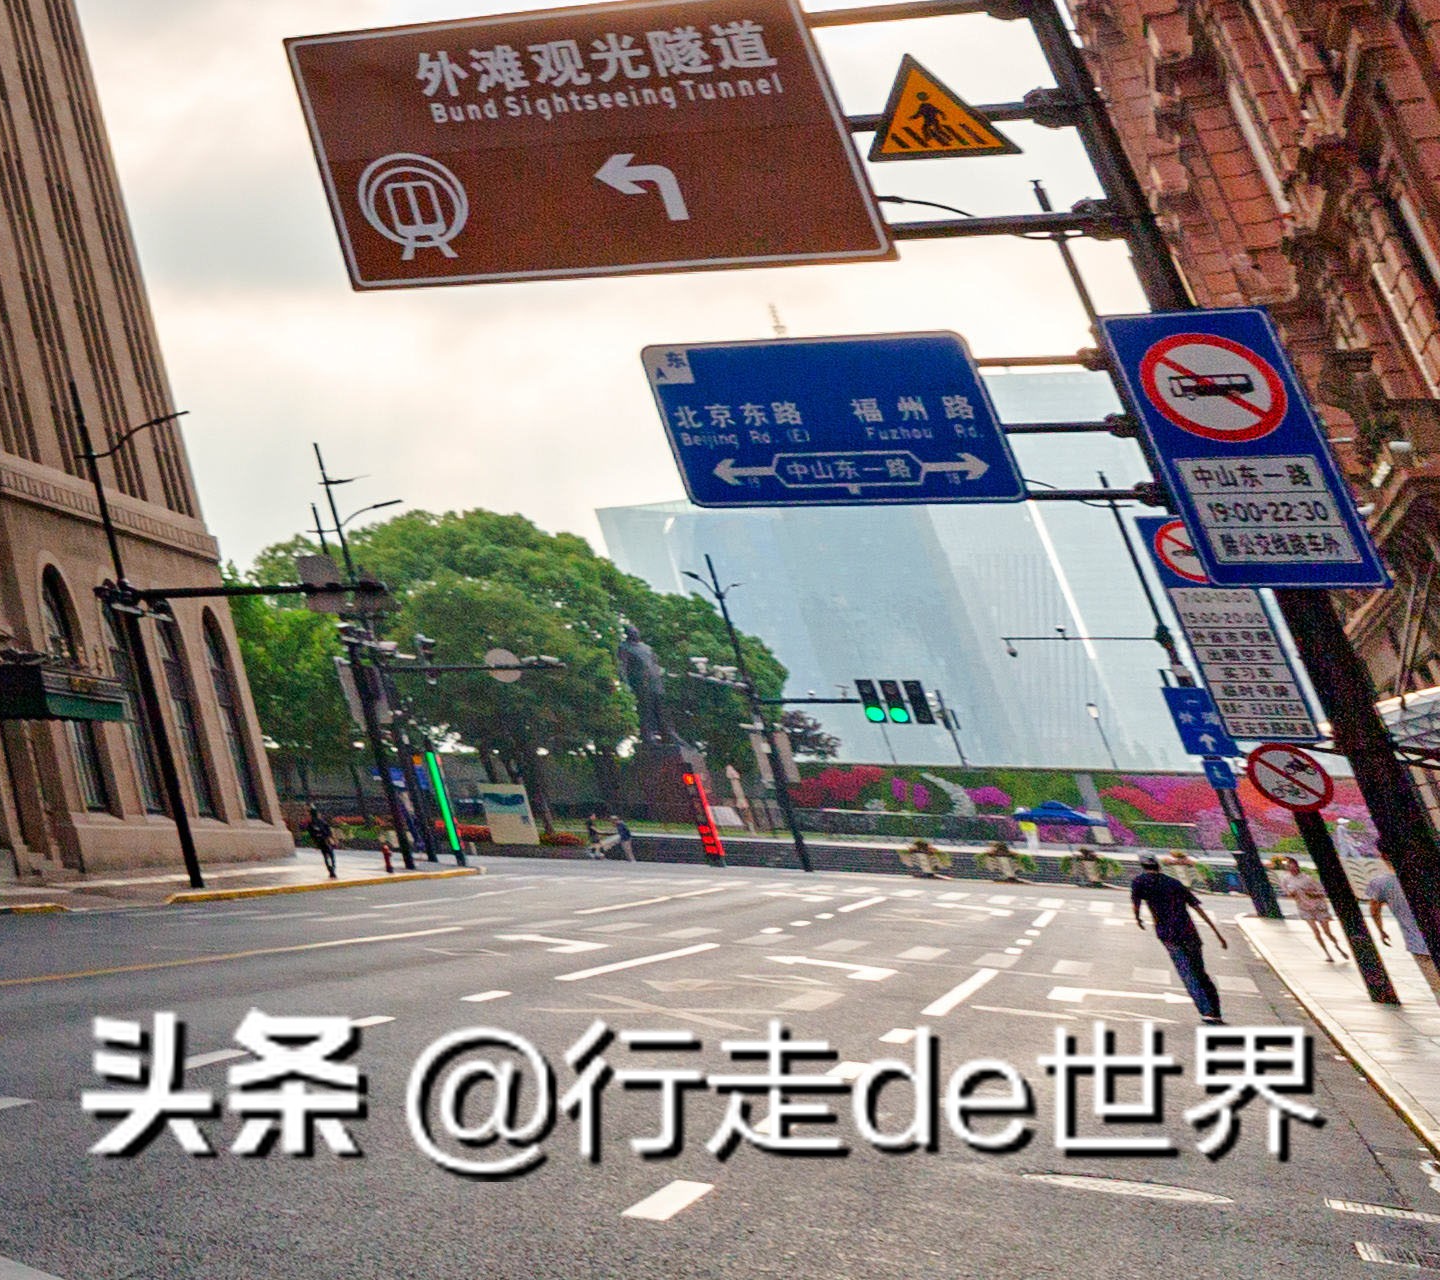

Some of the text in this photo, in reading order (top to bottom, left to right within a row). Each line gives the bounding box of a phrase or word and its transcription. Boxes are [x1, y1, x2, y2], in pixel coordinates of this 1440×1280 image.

[416, 20, 778, 97] 外滩观光隧道
[430, 72, 784, 124] Bund Sightseeing Tunnel
[674, 394, 975, 429] 北京东路 福州路
[680, 432, 740, 450] Beijing
[865, 426, 934, 440] Fuzhou
[786, 458, 913, 482] 中山东一路
[1192, 464, 1312, 488] 中山东一路
[1207, 500, 1329, 523] 19:00-22:30
